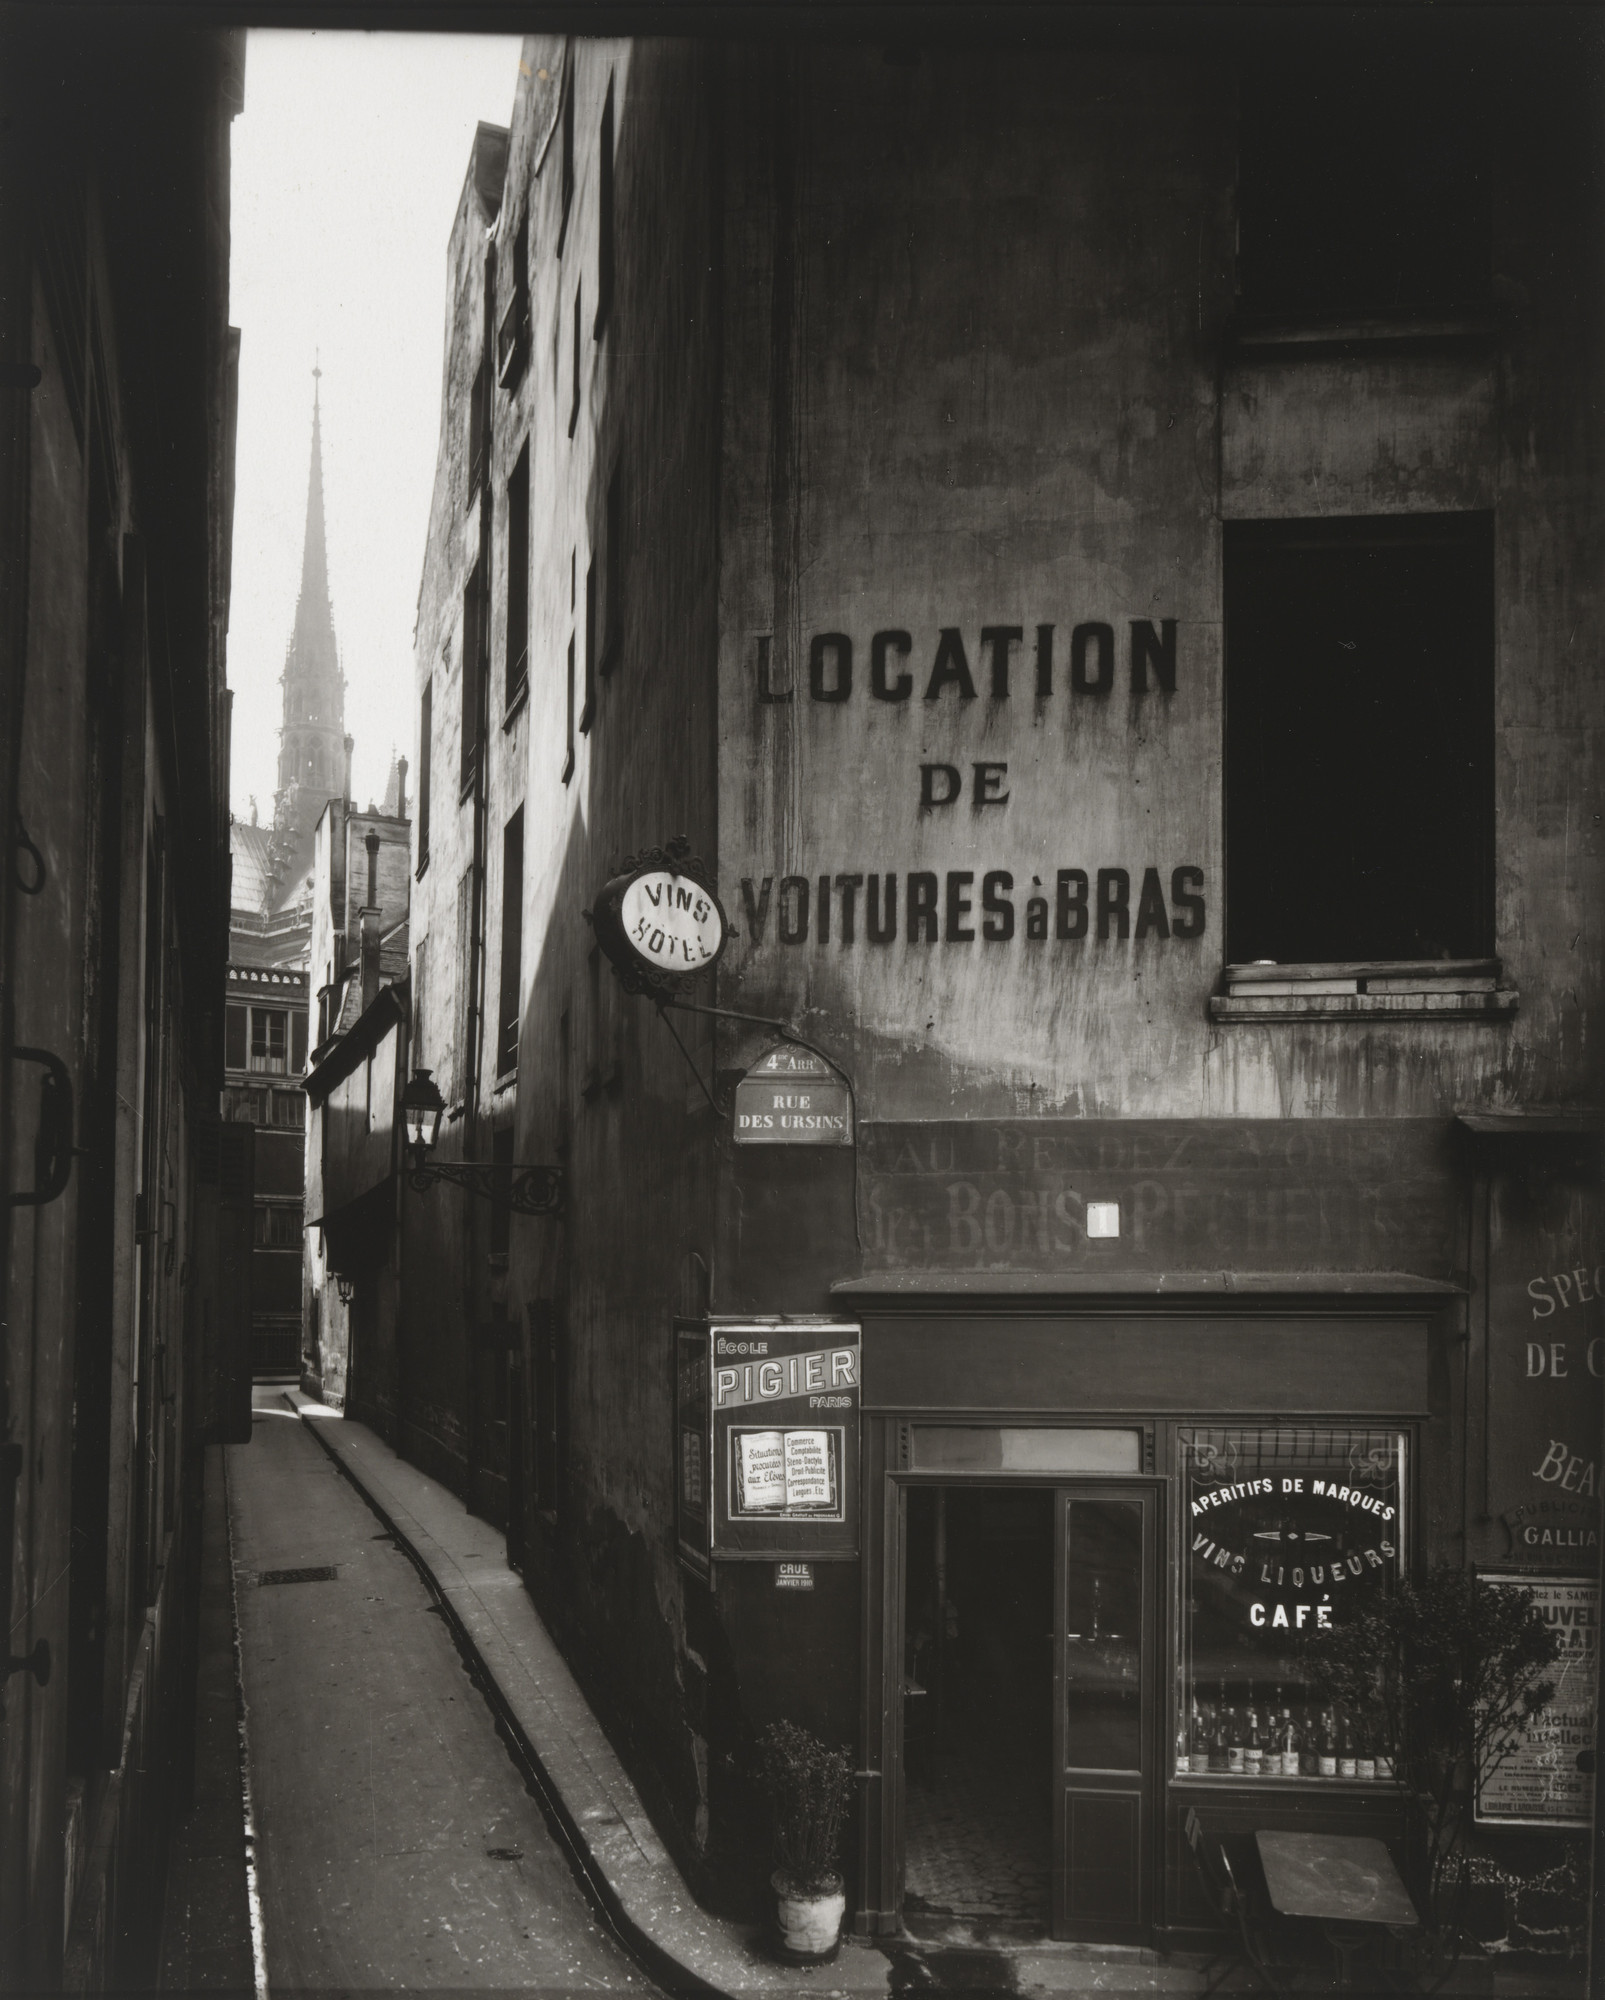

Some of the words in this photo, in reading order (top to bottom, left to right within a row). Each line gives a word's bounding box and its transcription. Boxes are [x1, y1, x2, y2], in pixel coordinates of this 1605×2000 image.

[757, 619, 1179, 703] LOCATION
[919, 763, 1011, 805] DE
[644, 883, 712, 924] VINS
[740, 873, 1014, 945] VOITURES
[1026, 875, 1048, 940] à
[1056, 867, 1205, 940] BRAS
[772, 1095, 811, 1109] RUE
[739, 1114, 774, 1129] DES
[781, 1115, 844, 1129] URSINS
[894, 1137, 955, 1171] AU
[717, 1337, 768, 1355] ÉCOLE
[1526, 1343, 1568, 1377] DE
[716, 1349, 857, 1406] PIGIER
[809, 1396, 852, 1408] PARIS
[786, 1437, 815, 1447] Commerce
[748, 1447, 783, 1460] Situations
[747, 1476, 761, 1484] aux
[787, 1477, 825, 1488] Correspondance
[1190, 1478, 1273, 1517] APERITIFS
[1282, 1478, 1304, 1493] DE
[1313, 1480, 1395, 1521] MARQUES
[1523, 1526, 1598, 1547] GALLIA
[779, 1563, 809, 1575] CRUE
[1191, 1533, 1245, 1573] VINS
[1260, 1540, 1396, 1588] LIQUEURS
[775, 1578, 799, 1587] JANVIER
[800, 1579, 813, 1587] 1910
[1553, 1590, 1561, 1600] le
[1249, 1594, 1333, 1629] CAFÉ
